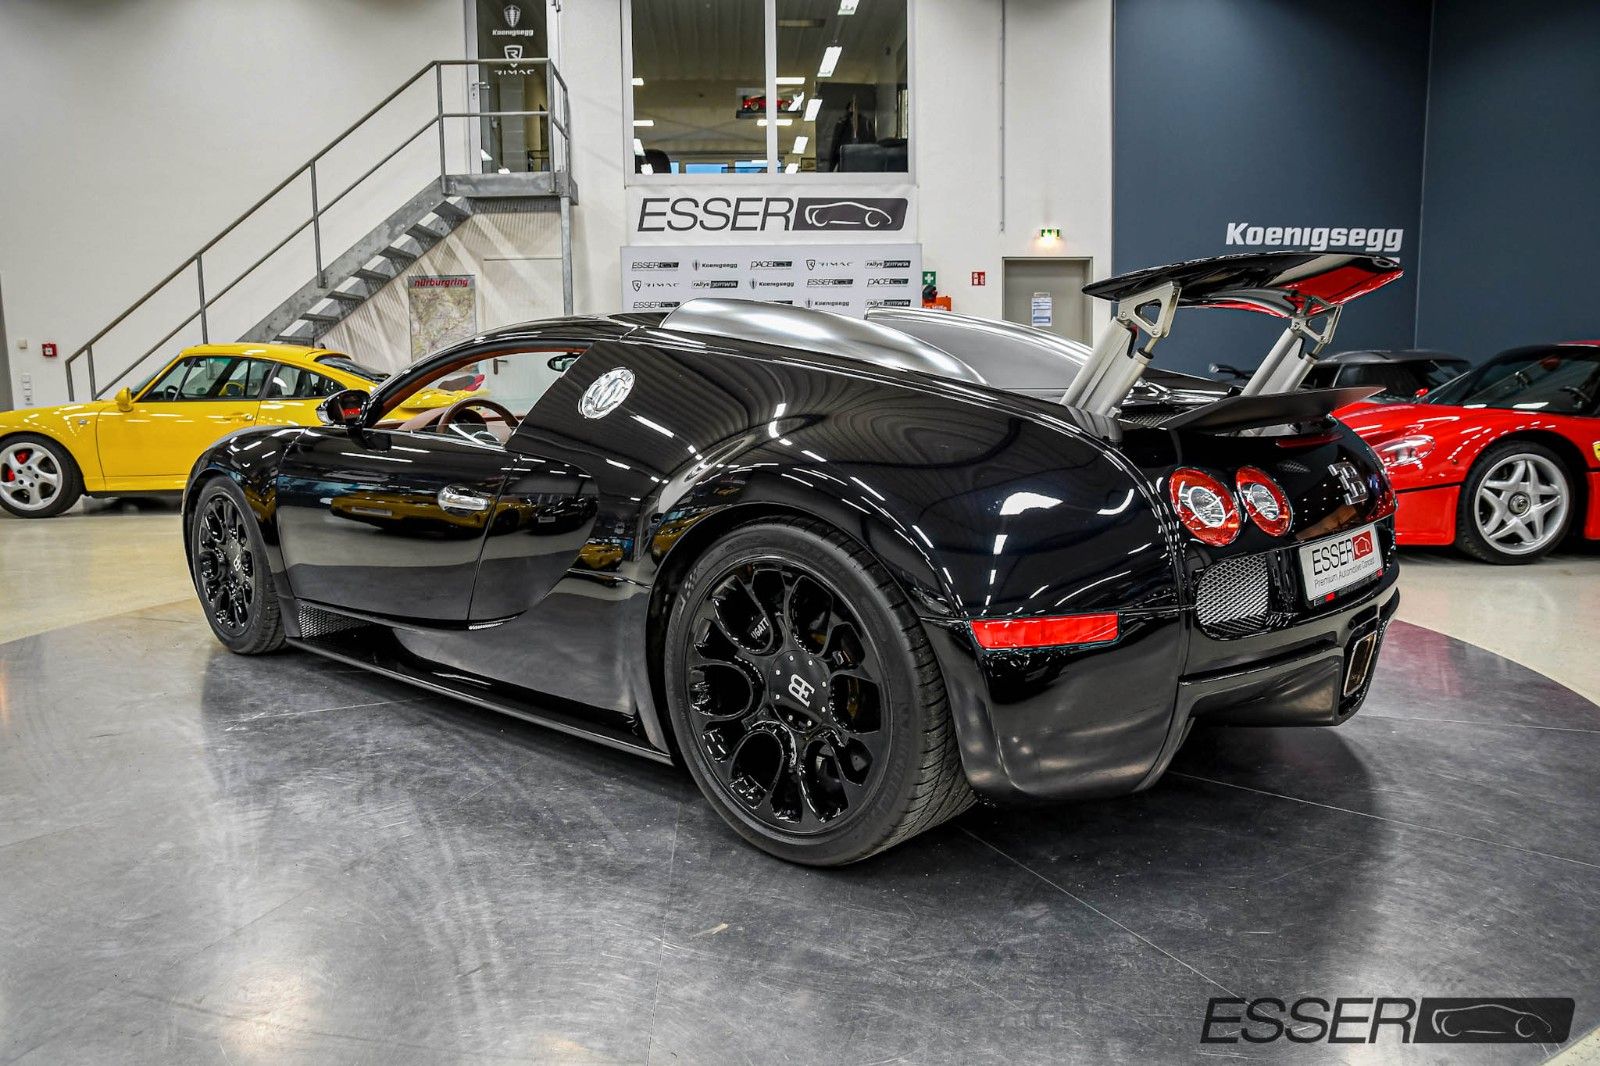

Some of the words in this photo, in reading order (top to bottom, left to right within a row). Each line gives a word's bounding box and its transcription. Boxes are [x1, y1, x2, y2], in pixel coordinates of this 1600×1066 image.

[492, 29, 534, 37] Koenigsegg
[637, 197, 794, 232] ESSER
[1225, 222, 1404, 253] Koenigsegg
[631, 261, 660, 269] ESSER
[1311, 538, 1355, 576] ESSER
